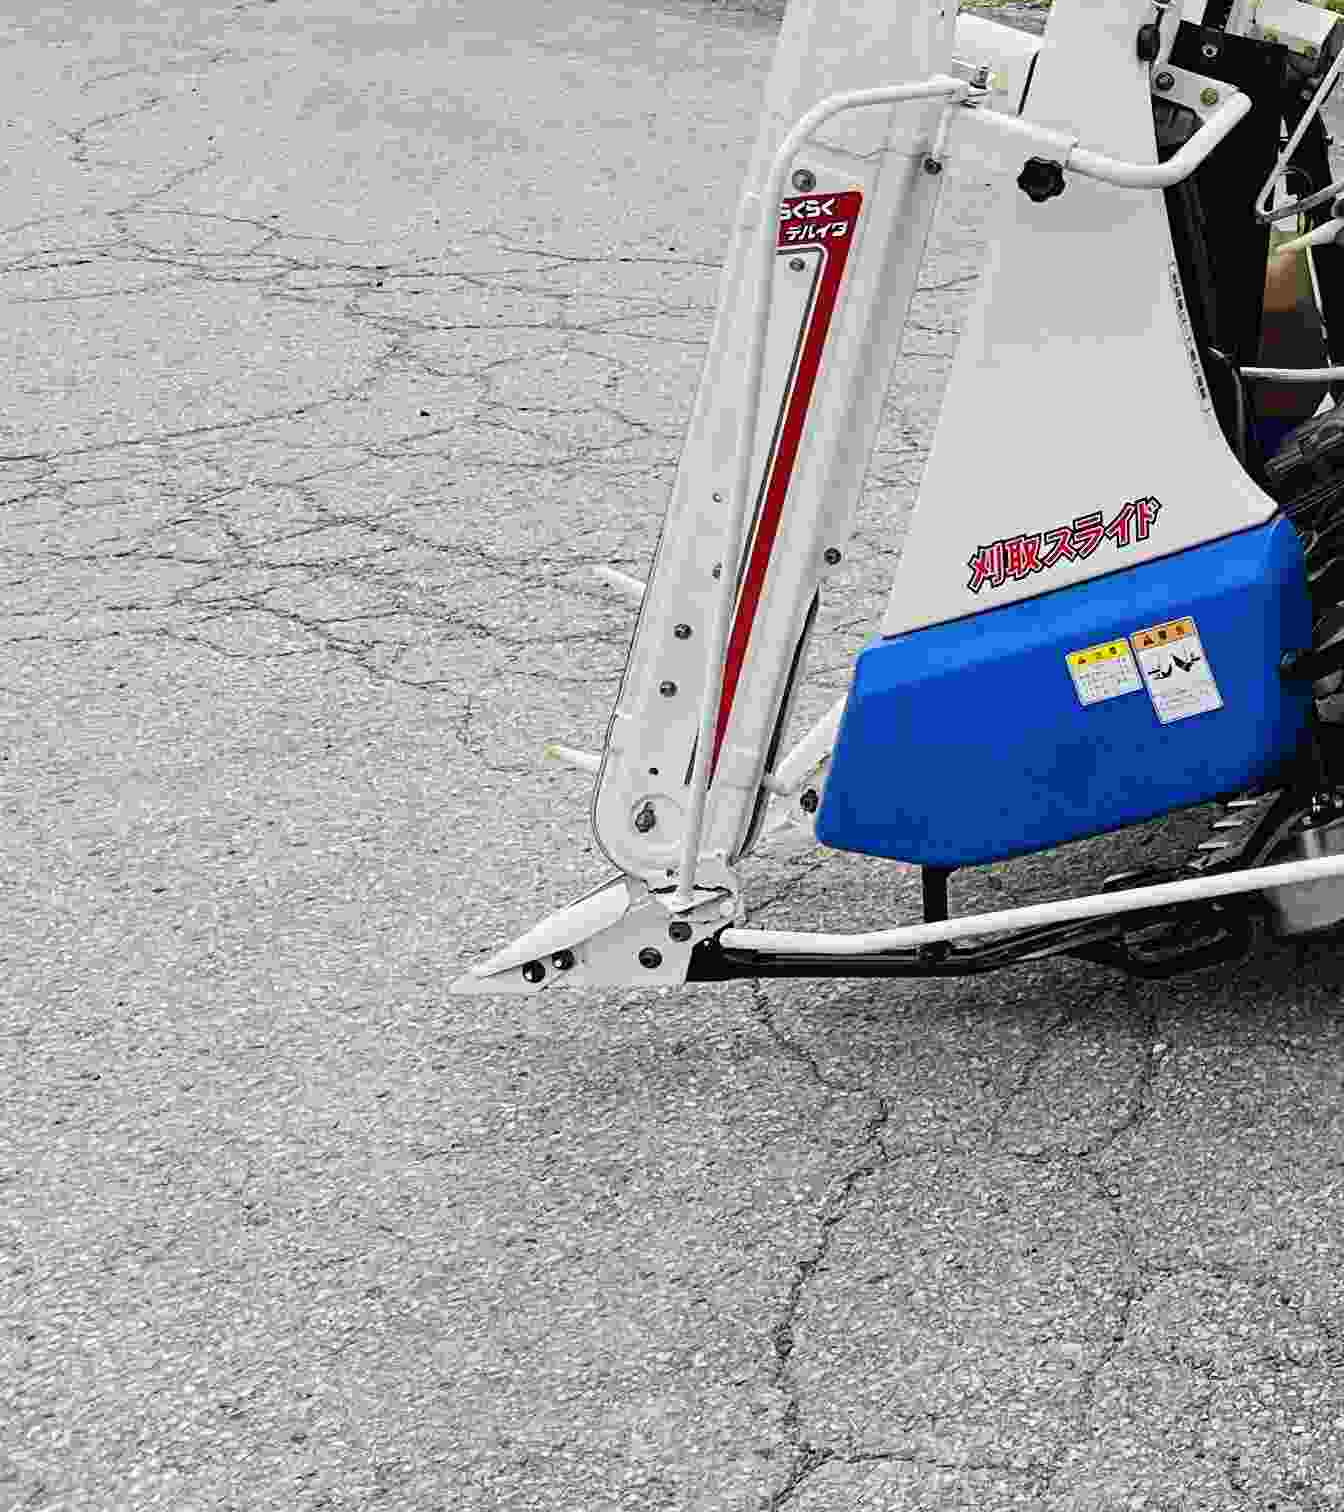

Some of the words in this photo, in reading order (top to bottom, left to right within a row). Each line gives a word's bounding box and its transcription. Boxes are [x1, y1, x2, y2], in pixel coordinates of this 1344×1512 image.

[968, 496, 1162, 593] 刈取スライド
